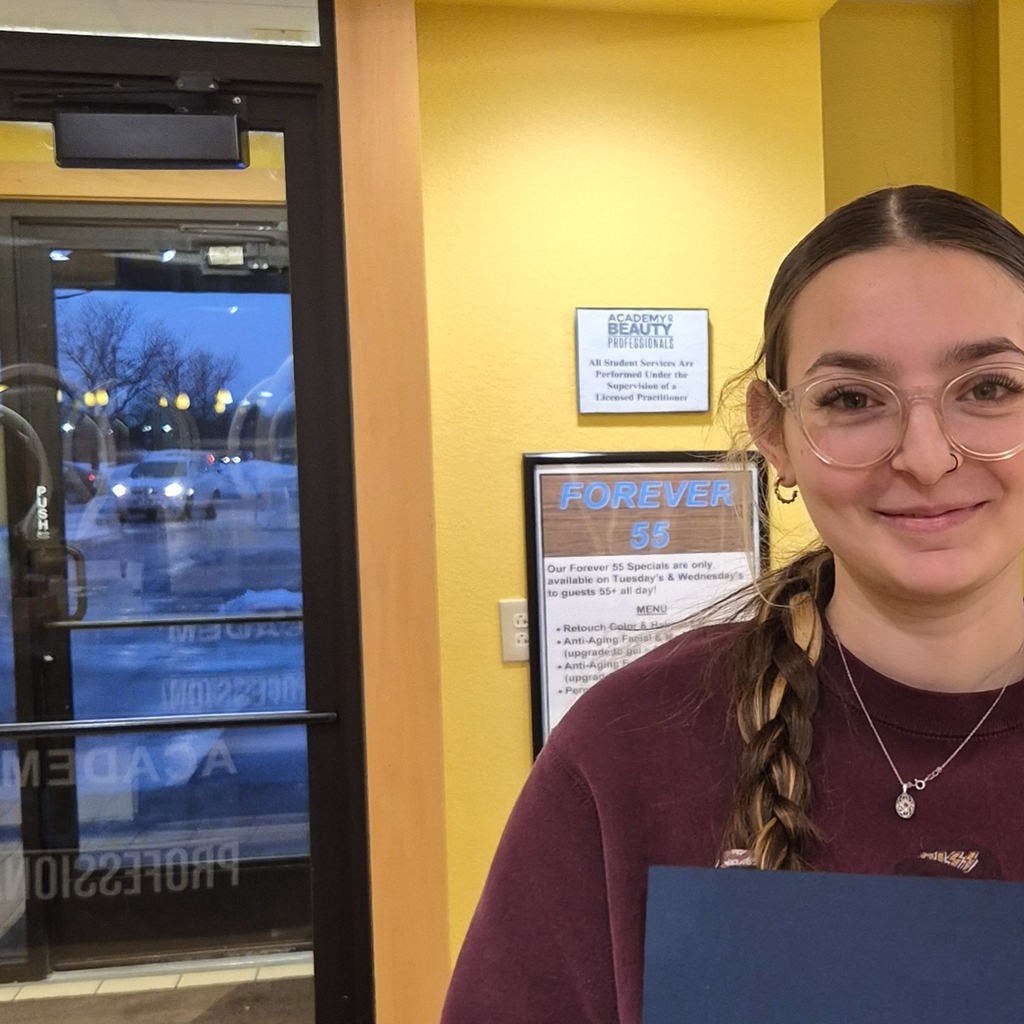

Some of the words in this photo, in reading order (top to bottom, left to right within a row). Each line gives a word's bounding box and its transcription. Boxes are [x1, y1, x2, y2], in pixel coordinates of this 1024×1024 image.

[608, 314, 666, 323] ACADEMY
[608, 323, 672, 335] BEAUTY
[608, 336, 674, 349] PROFESSIONALS
[589, 359, 602, 367] All
[604, 359, 638, 367] Student
[641, 359, 676, 367] Services
[596, 371, 642, 379] Performed
[645, 371, 671, 379] Under
[674, 371, 688, 379] the
[607, 382, 658, 392] Supervision
[661, 382, 670, 390] of
[596, 393, 634, 401] Licensed
[559, 479, 734, 511] FOREVER
[36, 486, 49, 530] PUSH
[629, 521, 671, 550] 55
[547, 565, 566, 573] Our
[570, 563, 609, 573] Forever
[612, 562, 624, 571] 55
[627, 562, 669, 573] Specials
[673, 562, 688, 570] are
[691, 560, 713, 572] only
[547, 575, 593, 585] available
[613, 573, 664, 586] Tuesday's
[668, 573, 675, 581] &
[678, 570, 744, 583] Wednesday's
[548, 589, 558, 597] to
[561, 588, 596, 599] guests
[600, 587, 617, 596] 55+
[620, 586, 632, 595] all
[636, 585, 657, 597] day!
[637, 605, 668, 615] MENU
[563, 623, 606, 633] Retouch
[609, 622, 637, 632] Color
[640, 621, 647, 630] &
[563, 636, 618, 646] Anti-Aging
[565, 660, 619, 671] Anti-Aging
